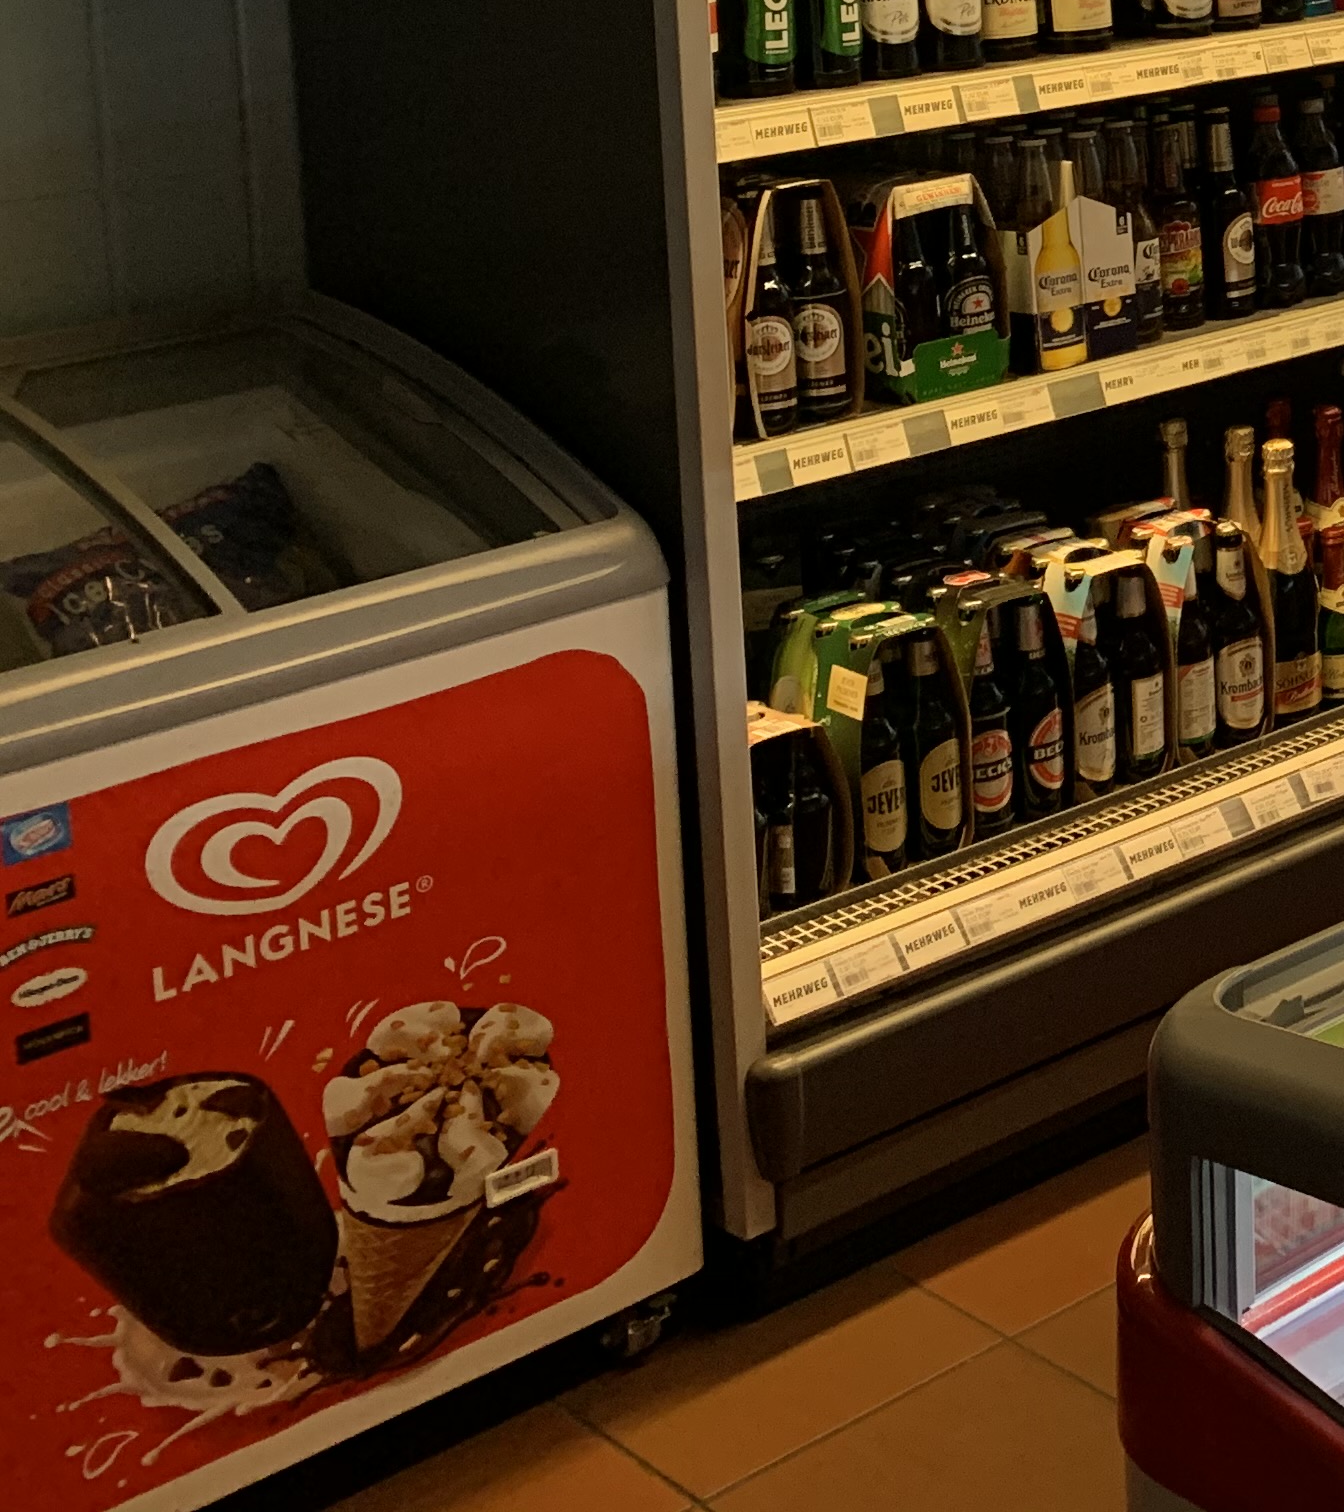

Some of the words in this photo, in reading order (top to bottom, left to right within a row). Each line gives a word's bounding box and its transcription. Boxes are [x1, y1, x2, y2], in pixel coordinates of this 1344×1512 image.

[1136, 65, 1180, 80] MEHRWEG
[1039, 79, 1084, 95] MEHRWEG
[903, 99, 953, 116] MEHRWEG
[755, 121, 808, 140] MEHRWEG
[1038, 271, 1079, 291] Corona
[1088, 264, 1131, 283] Corona
[1100, 277, 1123, 289] Extra
[950, 409, 998, 430] MEHRWEG
[793, 447, 844, 470] MEHRWEG
[1128, 837, 1175, 866] MEHRWEG
[1018, 879, 1068, 910] MEHRWEG
[904, 922, 956, 955] MEHRWEG
[772, 976, 828, 1010] MEHRWEG
[24, 1083, 69, 1120] cool
[99, 1050, 168, 1094] lekker!
